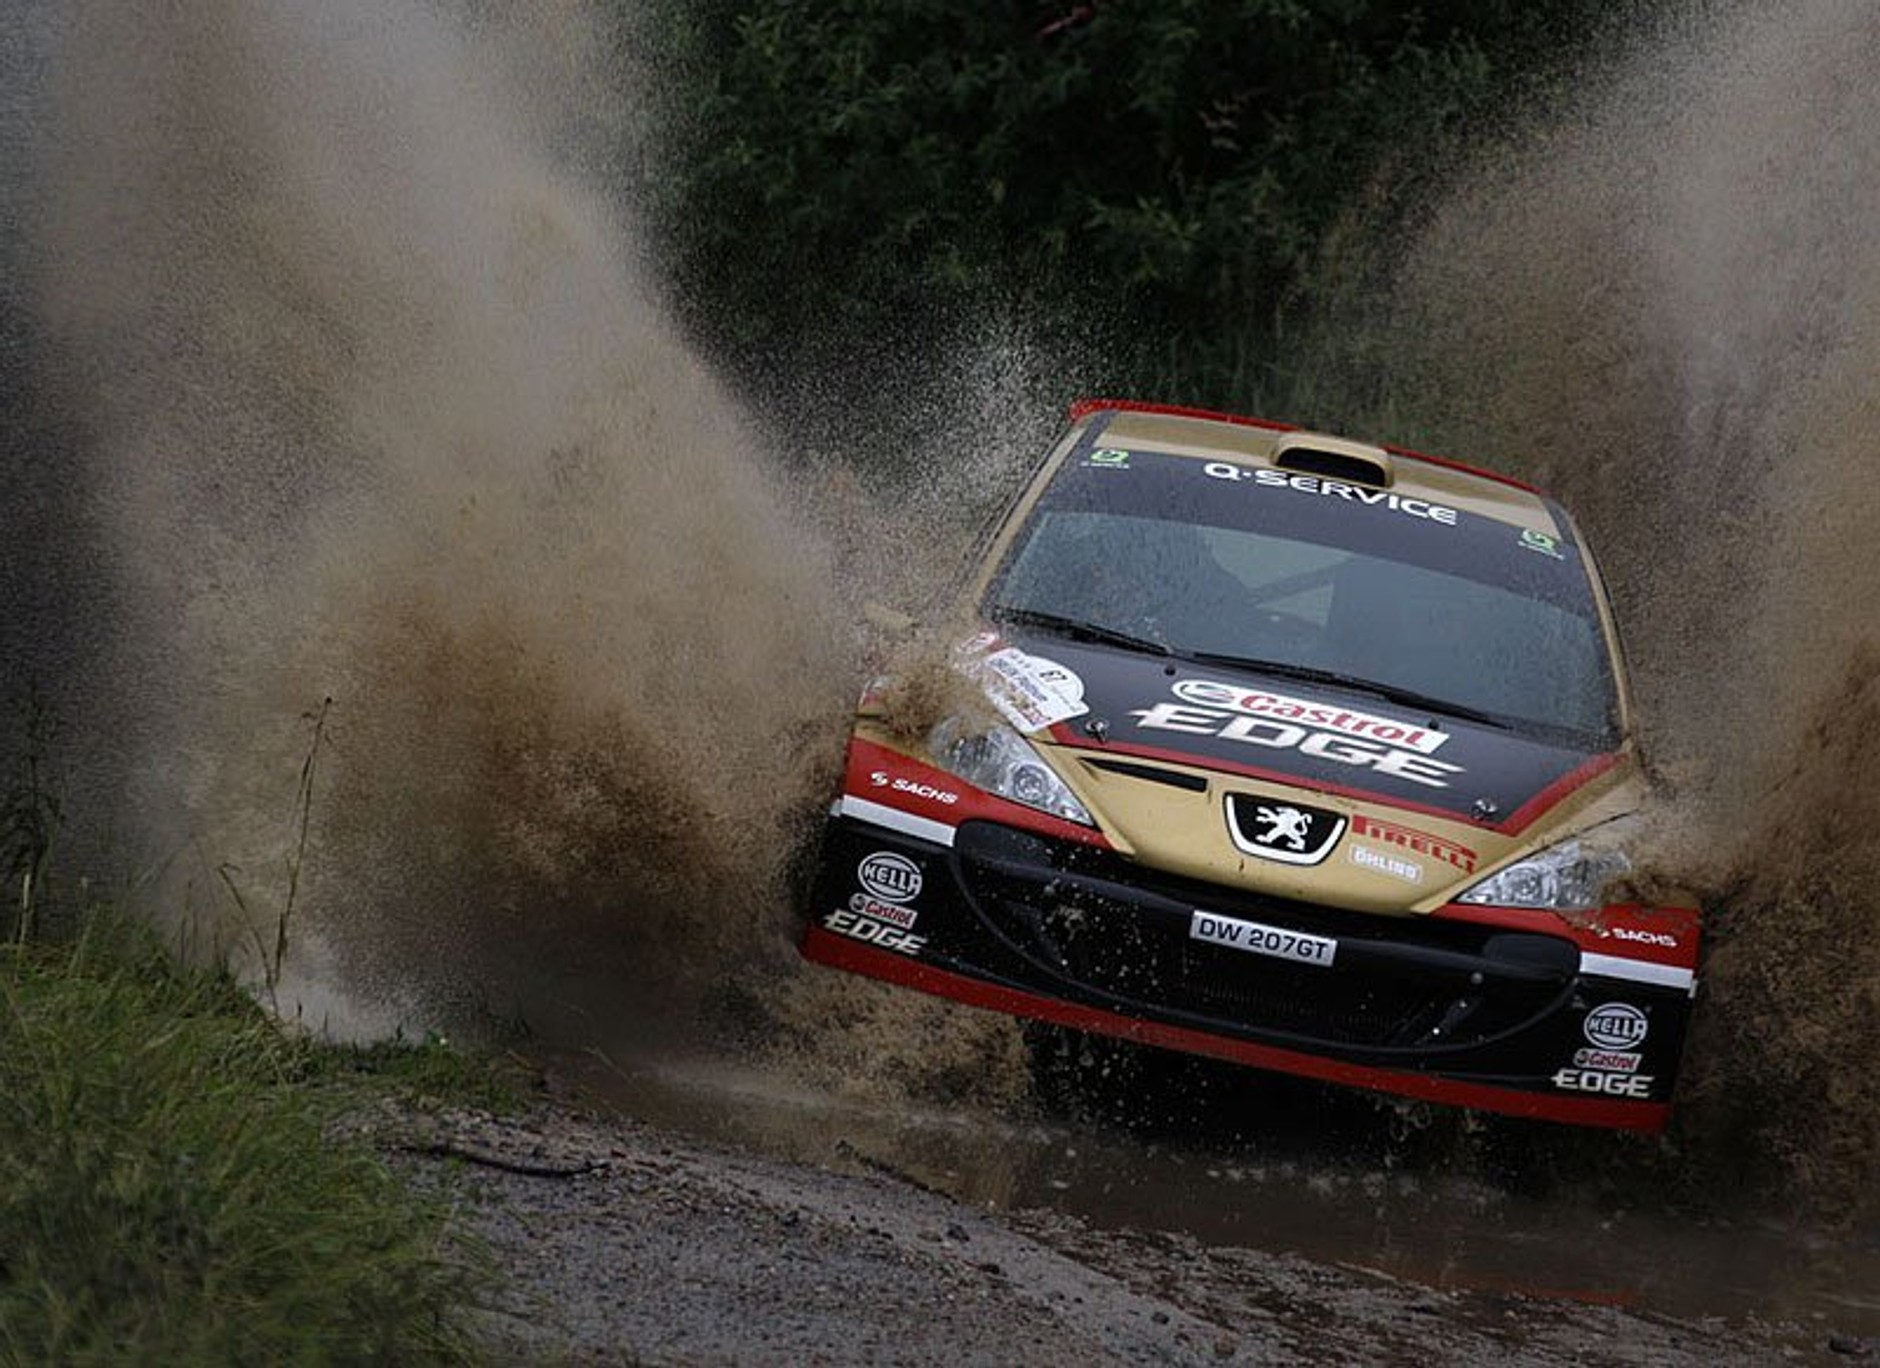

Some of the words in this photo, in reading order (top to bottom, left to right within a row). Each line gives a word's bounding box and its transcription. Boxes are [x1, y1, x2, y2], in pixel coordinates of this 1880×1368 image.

[1241, 694, 1429, 749] Castrol
[1126, 702, 1466, 788] EDGE
[891, 778, 958, 804] SACHS
[1352, 814, 1477, 875] PIRELLI
[863, 863, 923, 894] HELLA
[824, 909, 928, 955] EDGE
[1199, 918, 1242, 942] DW
[1248, 928, 1328, 959] 207GT
[1612, 927, 1677, 947] SACHS
[1588, 1017, 1647, 1040] HELLA
[1551, 1068, 1655, 1098] EDGE
